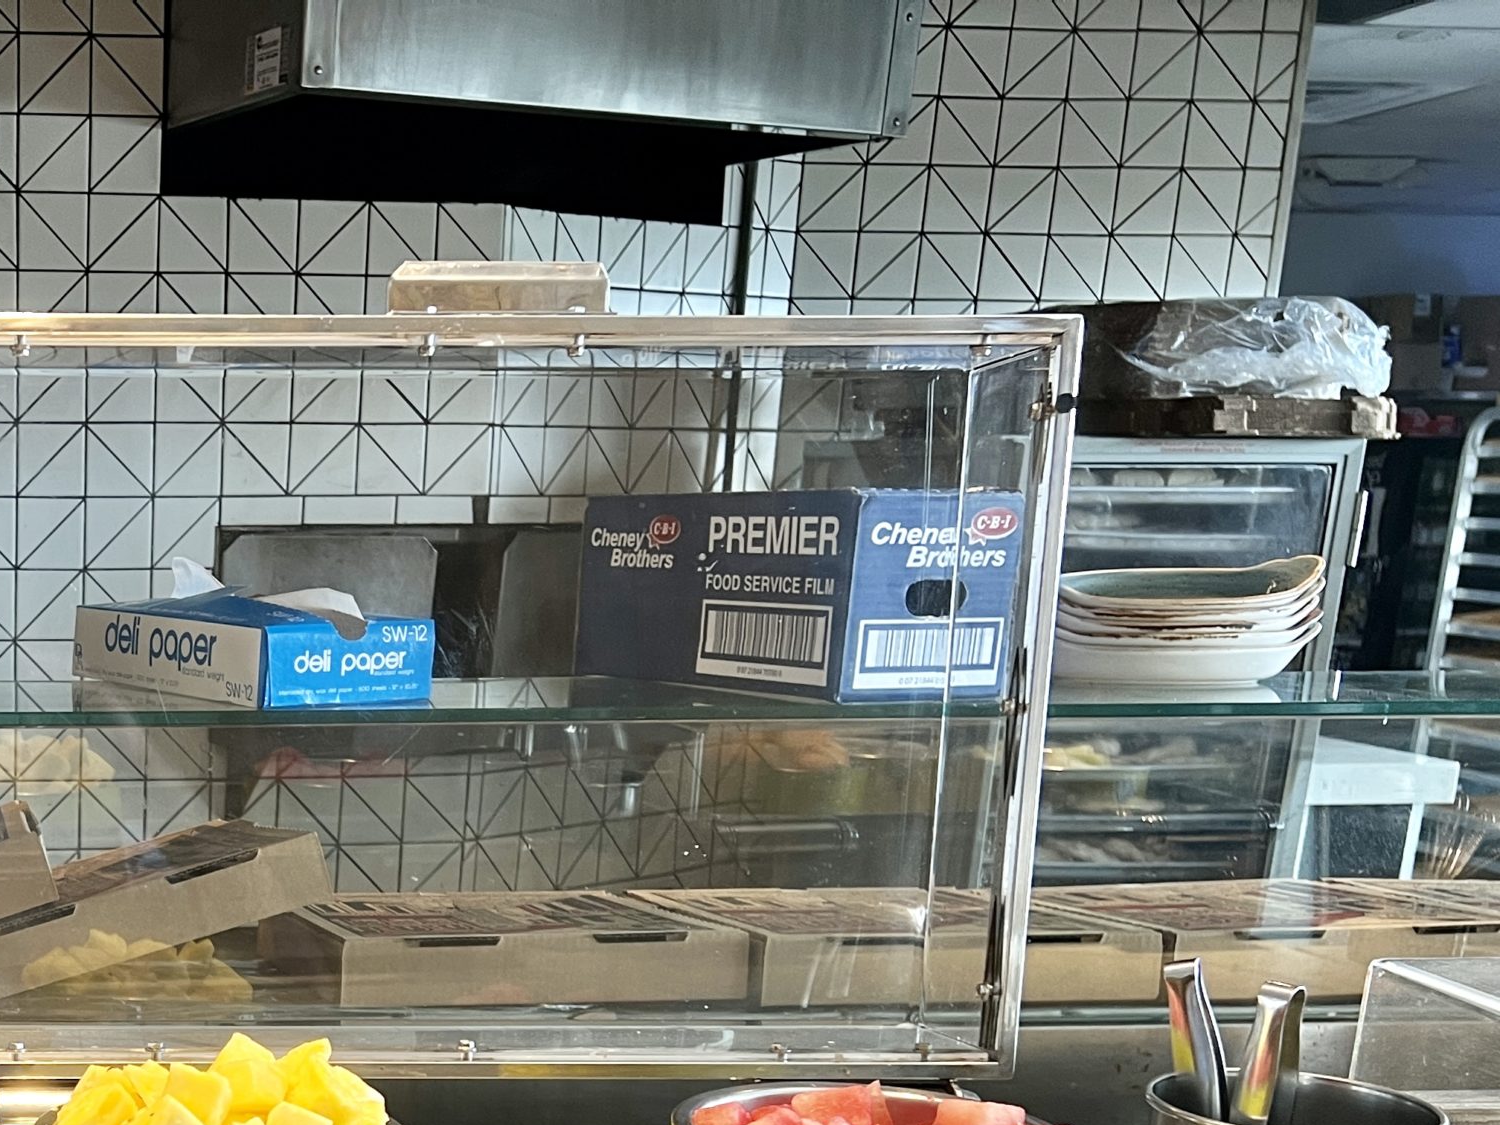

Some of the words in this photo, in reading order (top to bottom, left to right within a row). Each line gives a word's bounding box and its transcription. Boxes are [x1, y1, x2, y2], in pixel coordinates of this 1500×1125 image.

[591, 527, 646, 552] Cheney
[708, 515, 840, 555] PREMIER
[610, 547, 675, 569] Brothers
[705, 573, 741, 591] FOOD
[743, 574, 801, 594] SERVICE
[804, 577, 835, 596] FILM
[105, 614, 141, 656] deli
[149, 627, 217, 671] paper
[382, 624, 428, 643] SW-12
[293, 648, 332, 674] deli
[340, 651, 407, 676] paper
[225, 681, 253, 702] SW-12
